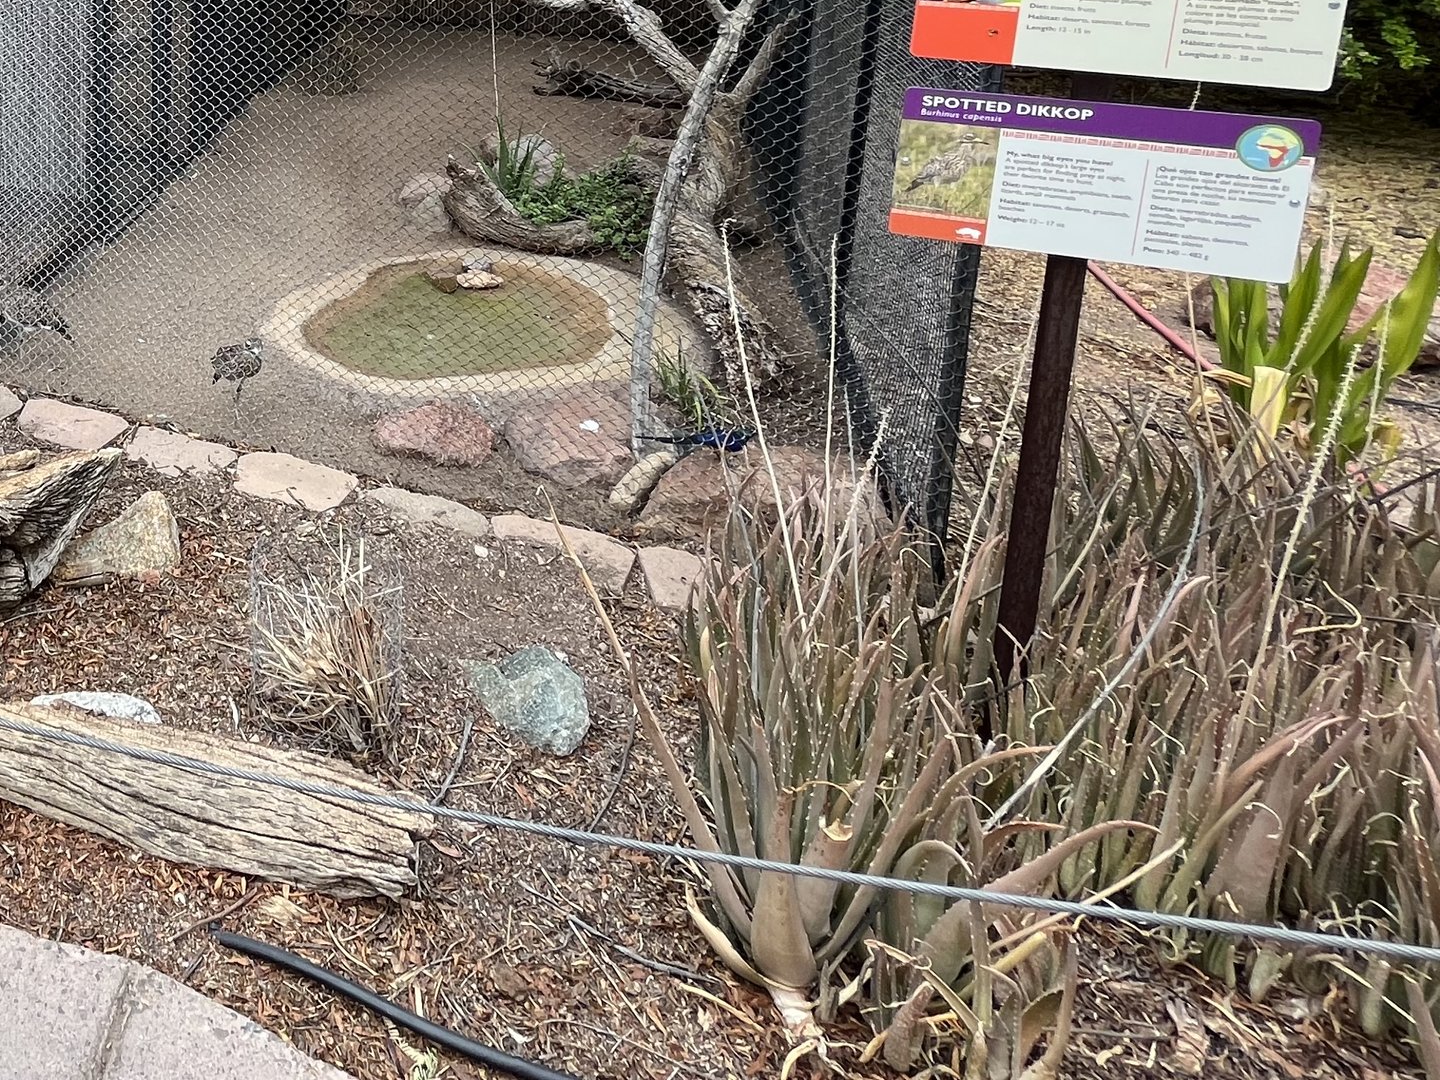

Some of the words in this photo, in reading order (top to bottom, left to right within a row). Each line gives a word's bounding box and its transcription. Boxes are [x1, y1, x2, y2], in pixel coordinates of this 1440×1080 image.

[920, 108, 960, 119] Burhinus
[962, 112, 1002, 123] capensis
[922, 95, 1011, 114] SPOTTED
[1016, 103, 1094, 121] DIKKOP
